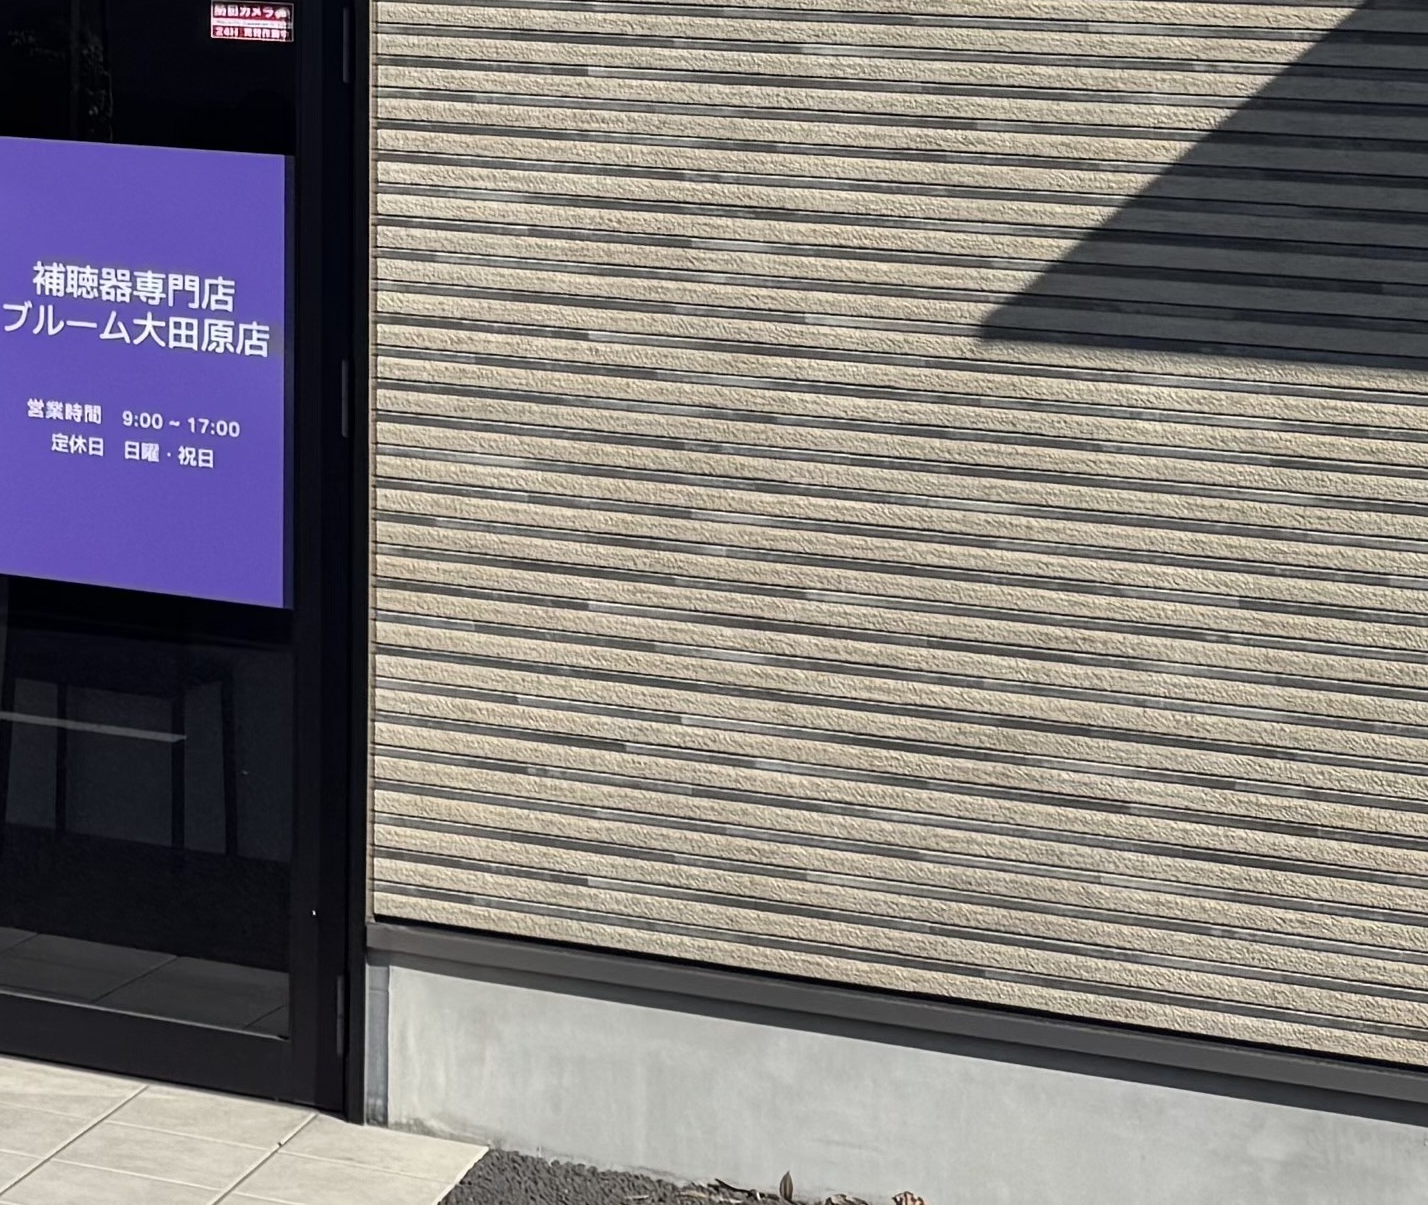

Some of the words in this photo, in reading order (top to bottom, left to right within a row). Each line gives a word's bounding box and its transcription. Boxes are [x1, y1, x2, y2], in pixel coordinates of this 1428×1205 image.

[32, 261, 235, 312] 補聴器専門店
[2, 301, 270, 357] ブルーム大田原店
[27, 398, 102, 425] 営業時間
[122, 410, 163, 430] 9:00
[187, 417, 240, 438] 17:00
[51, 432, 104, 457] 定休日
